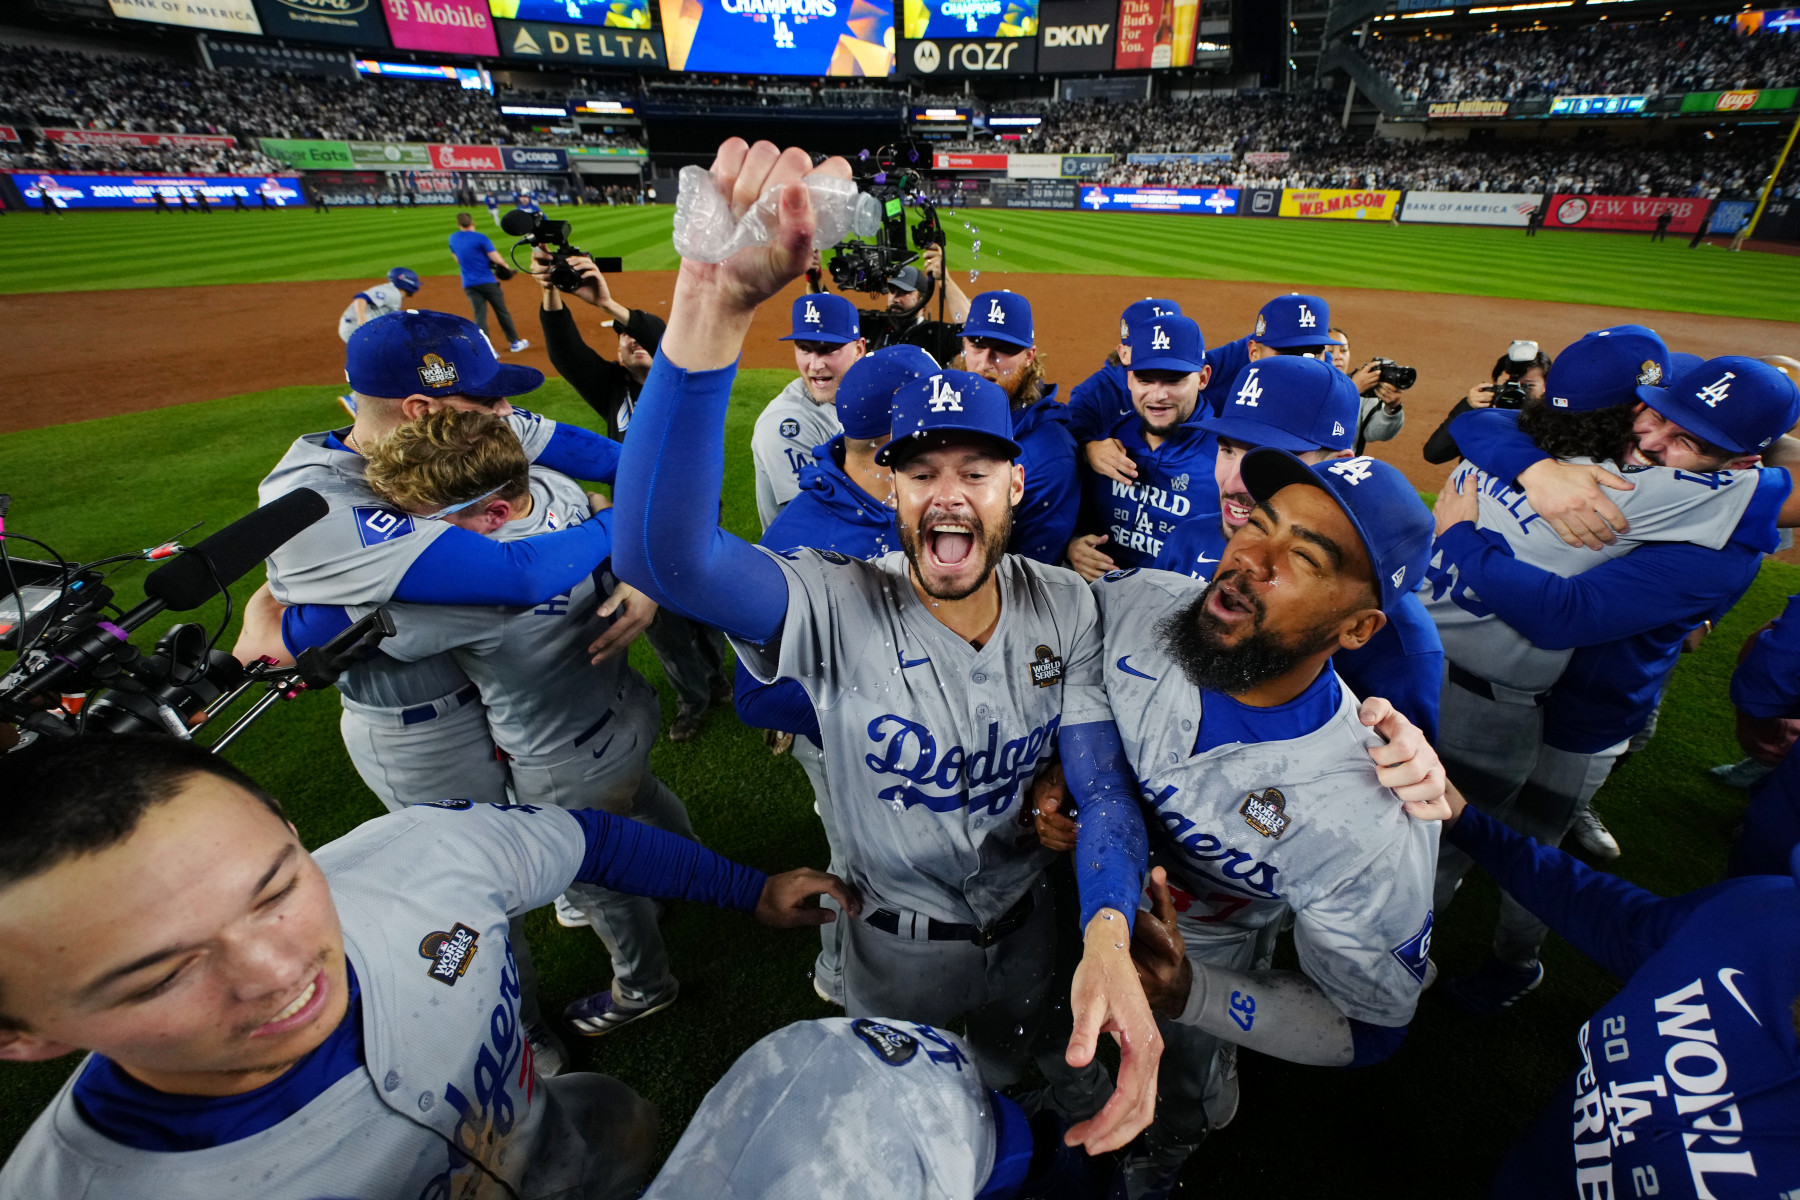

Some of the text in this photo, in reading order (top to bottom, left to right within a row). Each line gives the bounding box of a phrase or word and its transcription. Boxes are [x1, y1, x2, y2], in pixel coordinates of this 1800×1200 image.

[161, 2, 181, 12] OF
[186, 5, 254, 21] AMERICA
[415, 1, 487, 29] Mobile
[1124, 0, 1150, 13] This
[1123, 13, 1153, 27] Bud's
[548, 31, 657, 59] DELTA
[1044, 24, 1110, 47] DKNY
[1120, 40, 1145, 53] You.
[1122, 28, 1141, 40] For
[949, 42, 1018, 70] razr
[1457, 101, 1508, 113] Authority
[308, 149, 349, 162] Eats
[1406, 203, 1508, 213] BANK OF AMERICA
[1589, 200, 1693, 218] F.W. WEBB
[804, 300, 821, 323] LA
[988, 299, 1005, 325] LA
[1153, 307, 1174, 317] L
[1298, 305, 1316, 328] LA
[1151, 325, 1170, 350] LA
[929, 374, 963, 412] LA
[1236, 368, 1263, 407] LA
[1695, 371, 1736, 408] LA
[782, 425, 797, 435] 34
[1328, 456, 1374, 486] LA
[1112, 480, 1191, 517] WORLD
[1114, 508, 1129, 521] 20
[1135, 504, 1153, 535] LA
[1032, 661, 1060, 673] WORLD
[1035, 668, 1060, 680] SERIES
[865, 713, 1060, 815] Dodger
[1246, 806, 1280, 833] SERIES
[1250, 798, 1284, 827] WORLD
[434, 929, 466, 974] WORLD
[445, 934, 473, 978] SERIES
[1228, 990, 1257, 1032] 37
[1603, 1015, 1630, 1063] 20
[1602, 1074, 1668, 1148] LA
